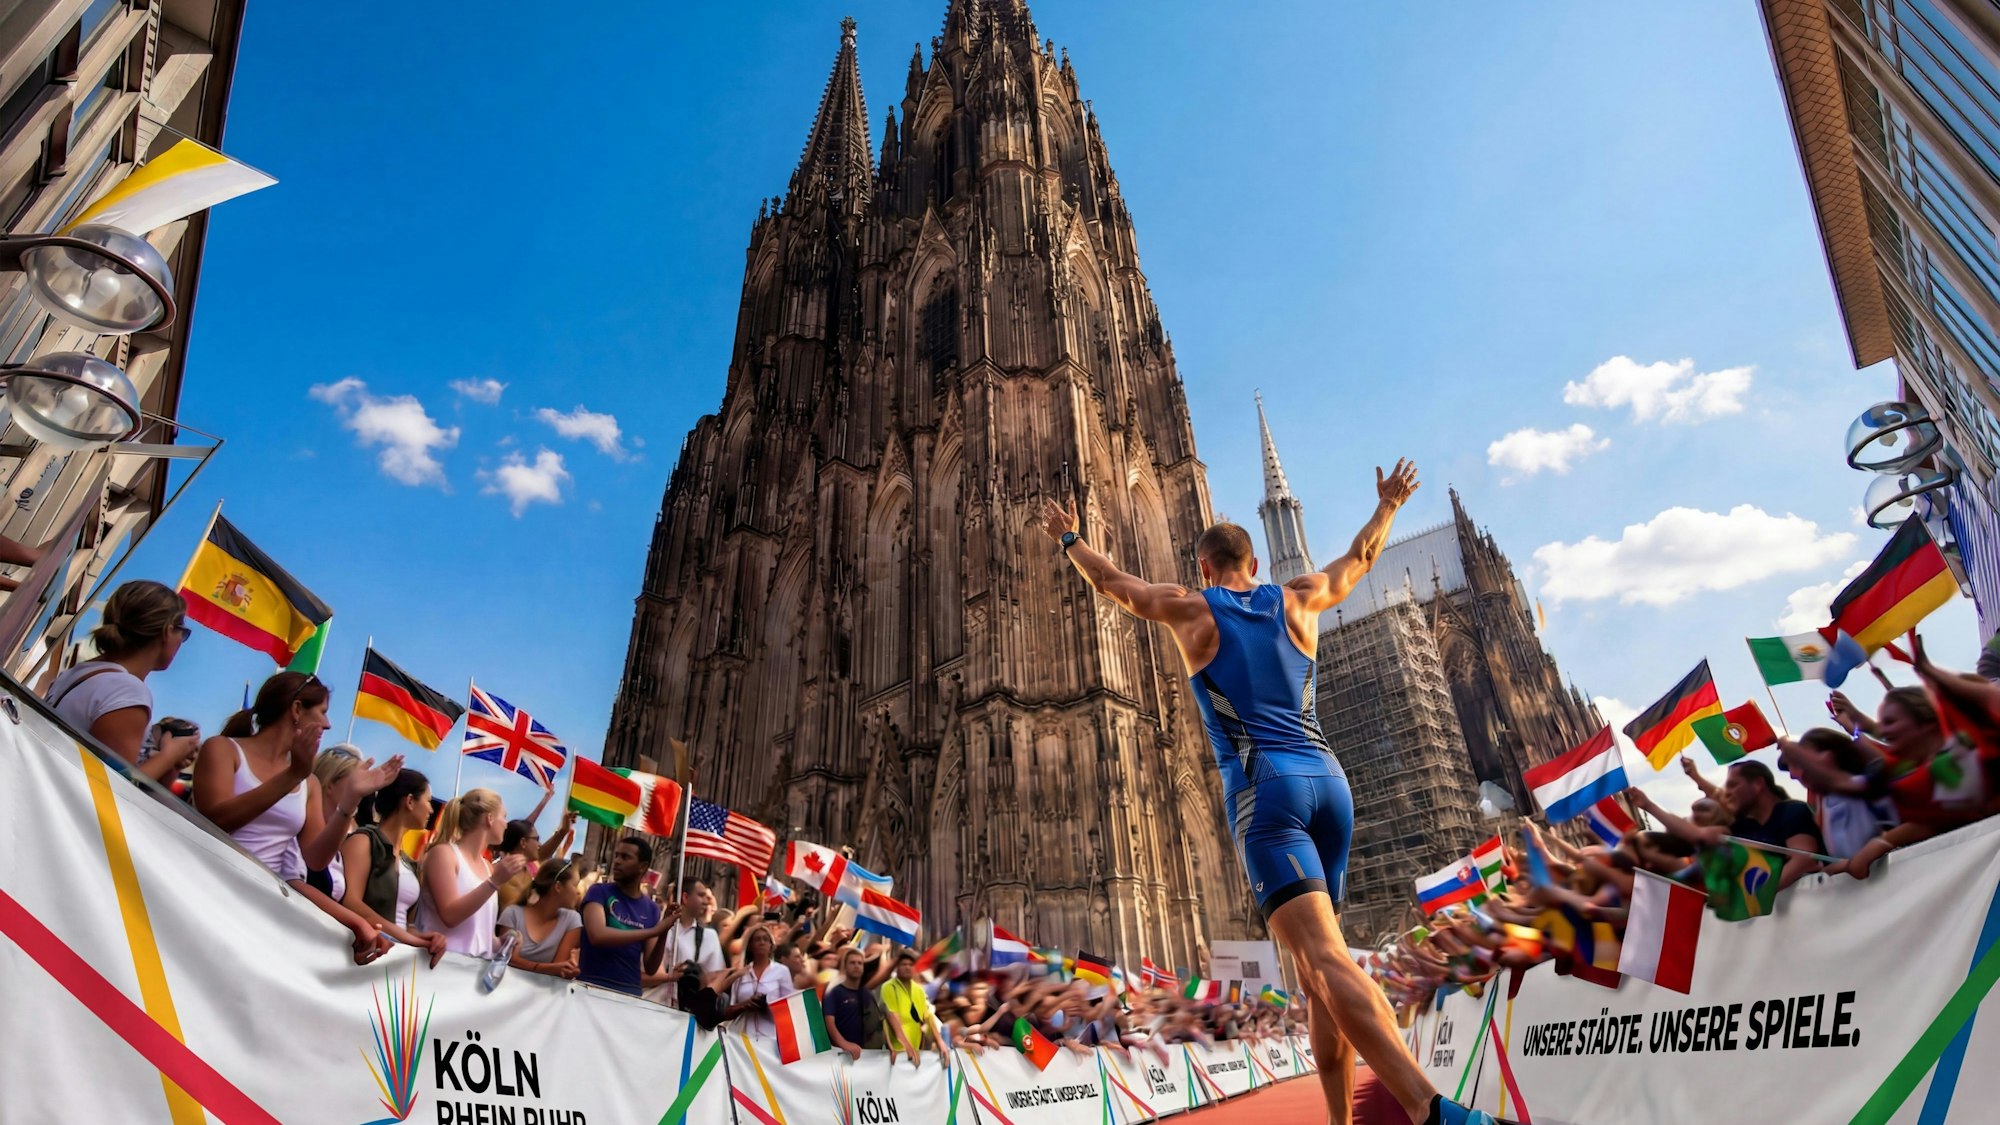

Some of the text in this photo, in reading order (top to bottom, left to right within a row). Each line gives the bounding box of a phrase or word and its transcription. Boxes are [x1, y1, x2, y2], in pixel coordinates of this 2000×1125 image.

[1523, 990, 1860, 1056] UNSERE STÄDTE. UNSERE SPIELE.
[434, 1030, 541, 1098] KÖLN
[856, 1091, 899, 1124] KÖLN
